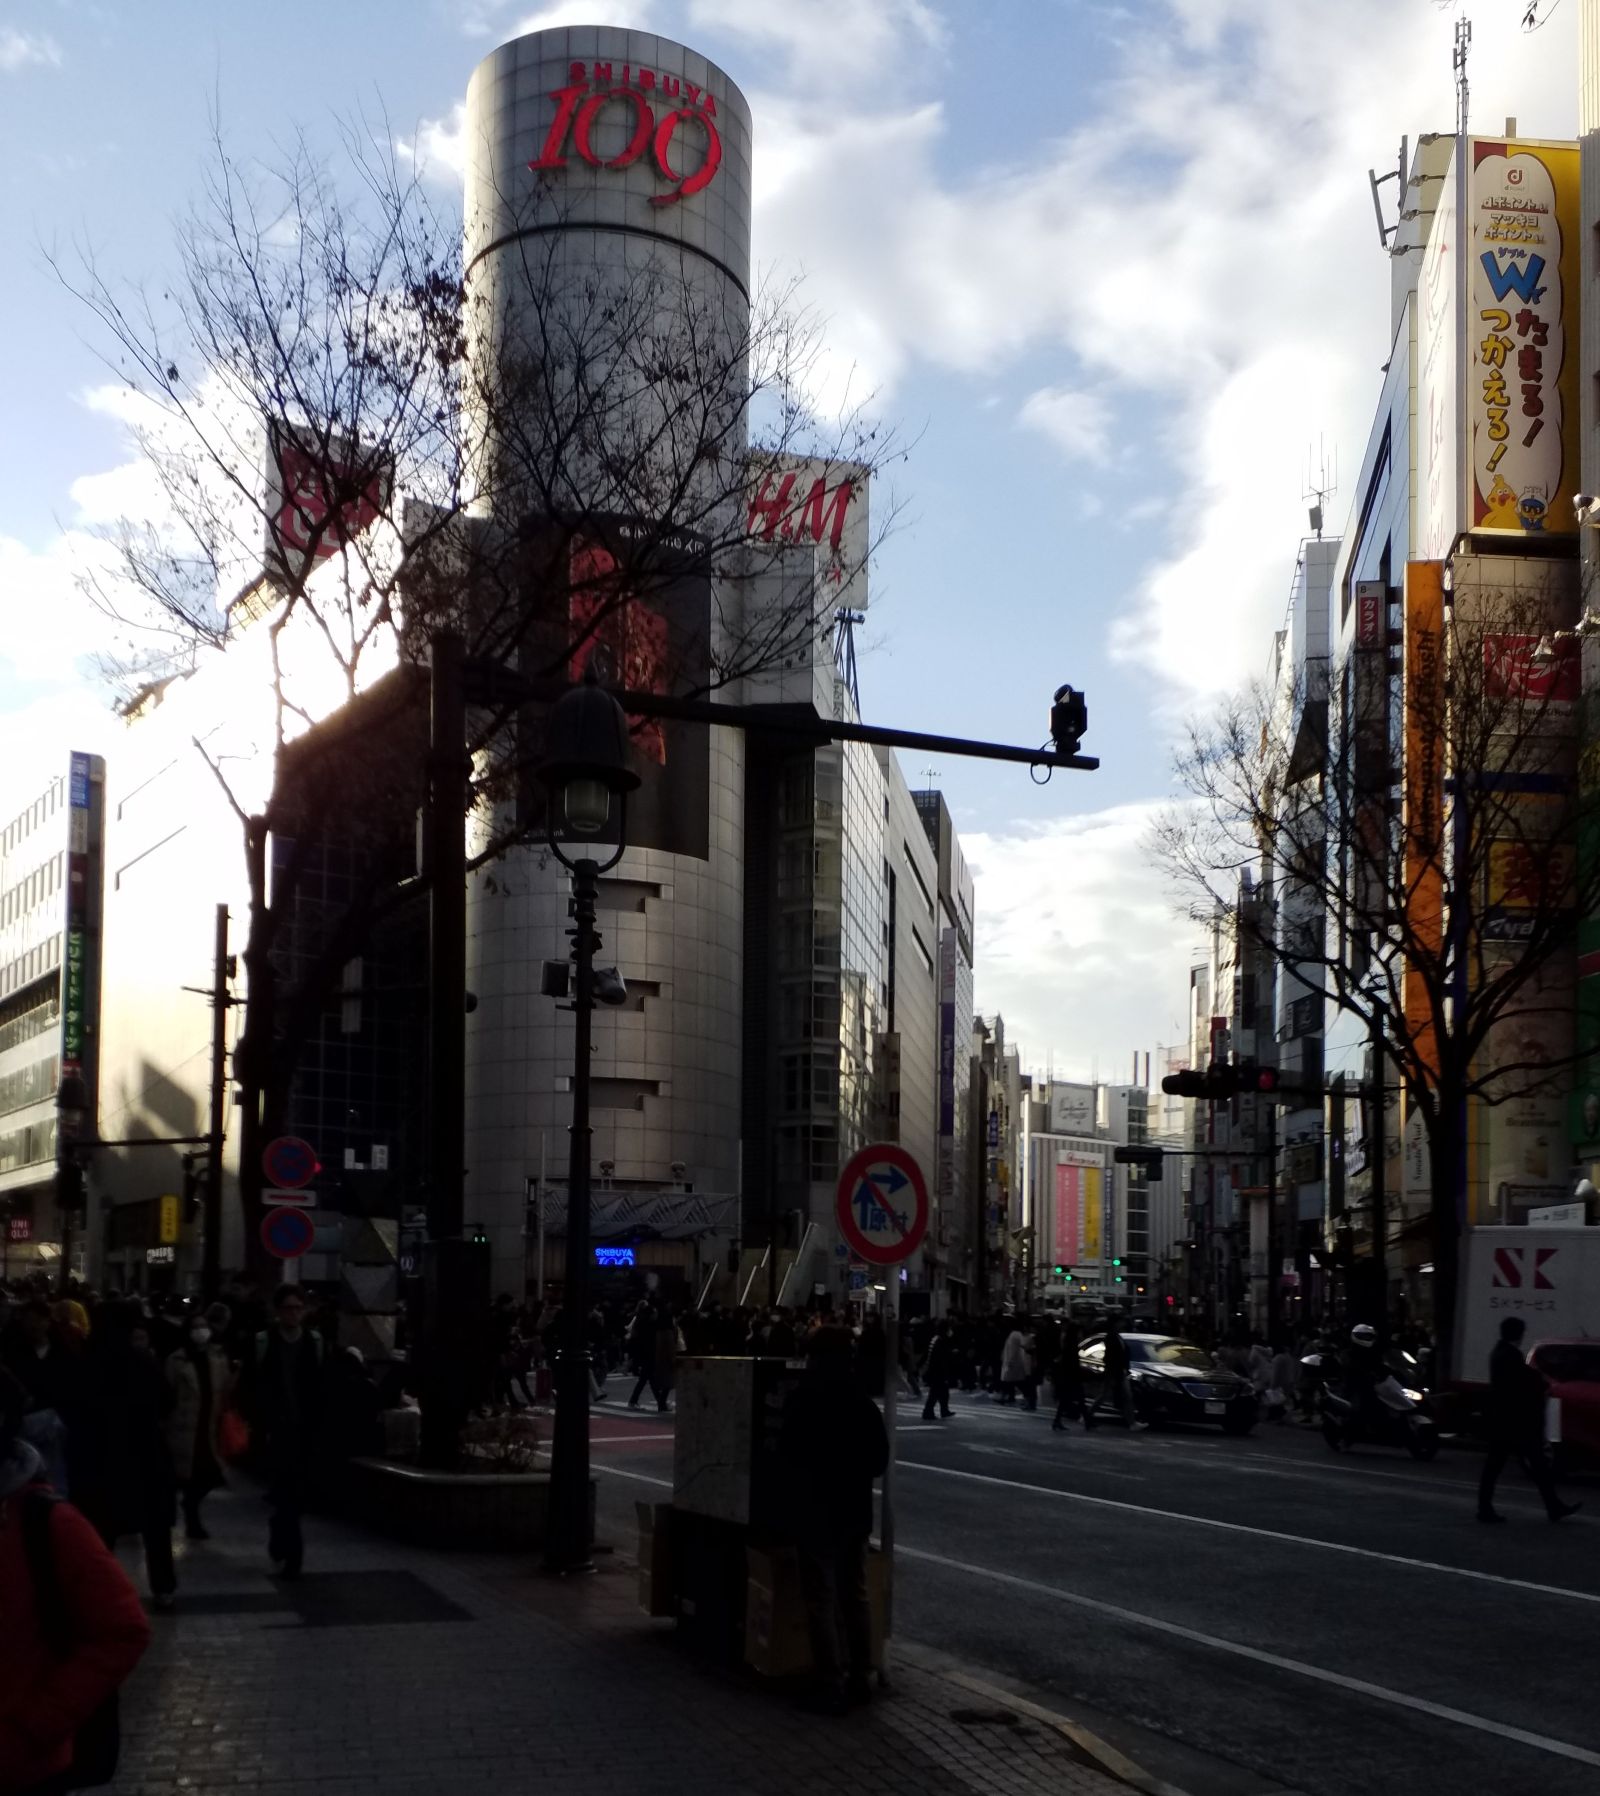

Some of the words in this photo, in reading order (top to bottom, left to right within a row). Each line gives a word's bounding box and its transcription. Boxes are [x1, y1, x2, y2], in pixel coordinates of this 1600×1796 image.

[569, 61, 718, 117] SHIBUYA
[528, 82, 722, 208] 109
[746, 471, 855, 550] H&M
[594, 1247, 634, 1257] SHIBUYA
[1491, 1247, 1561, 1290] SK
